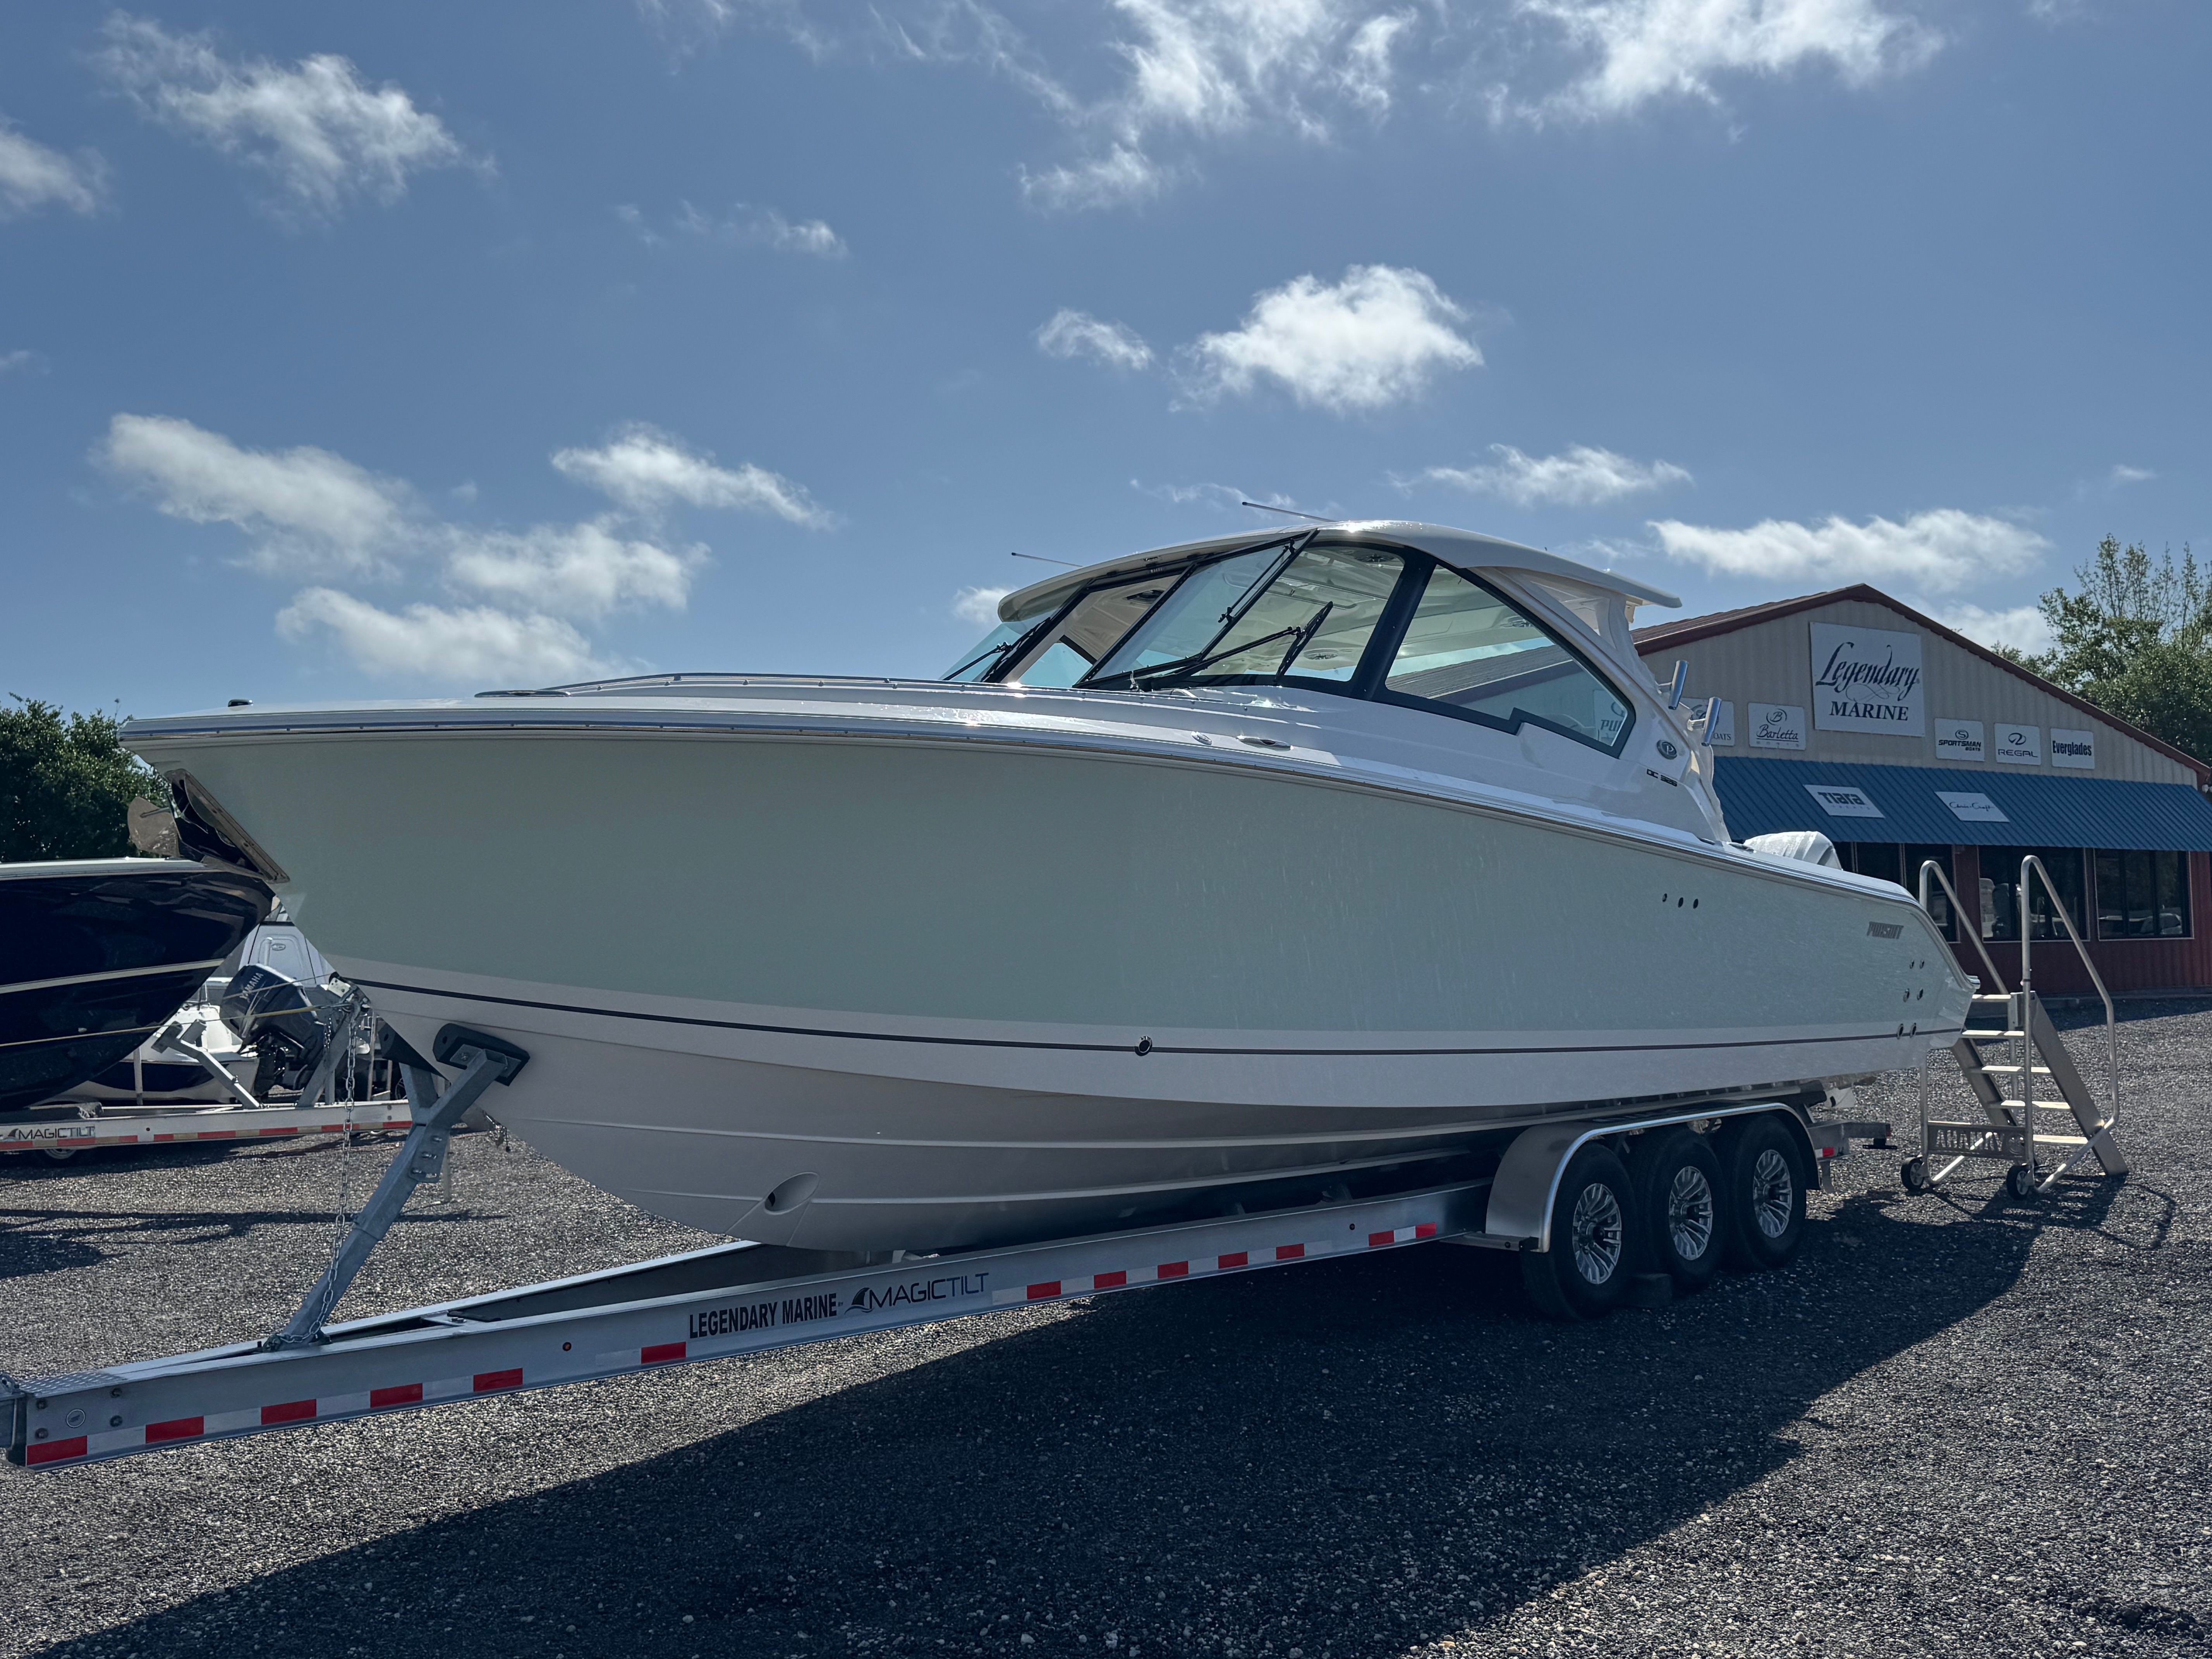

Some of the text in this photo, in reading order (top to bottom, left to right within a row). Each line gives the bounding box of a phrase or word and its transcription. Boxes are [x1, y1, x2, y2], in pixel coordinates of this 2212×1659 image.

[1815, 642, 1919, 701] Legendary
[1829, 701, 1909, 721] MARINE
[1756, 724, 1798, 740] Barletta
[1938, 739, 1981, 747] SPORTSMAN
[2052, 740, 2092, 756] Everglades
[1998, 749, 2039, 758] REGAL
[1647, 768, 1659, 779] DC
[1867, 921, 1904, 939] PURSUIT
[19, 1126, 96, 1140] MAGICTILT
[690, 1302, 778, 1339] LEGENDARY
[782, 1293, 837, 1324] MARINE
[869, 1273, 989, 1309] MAGICTILT
